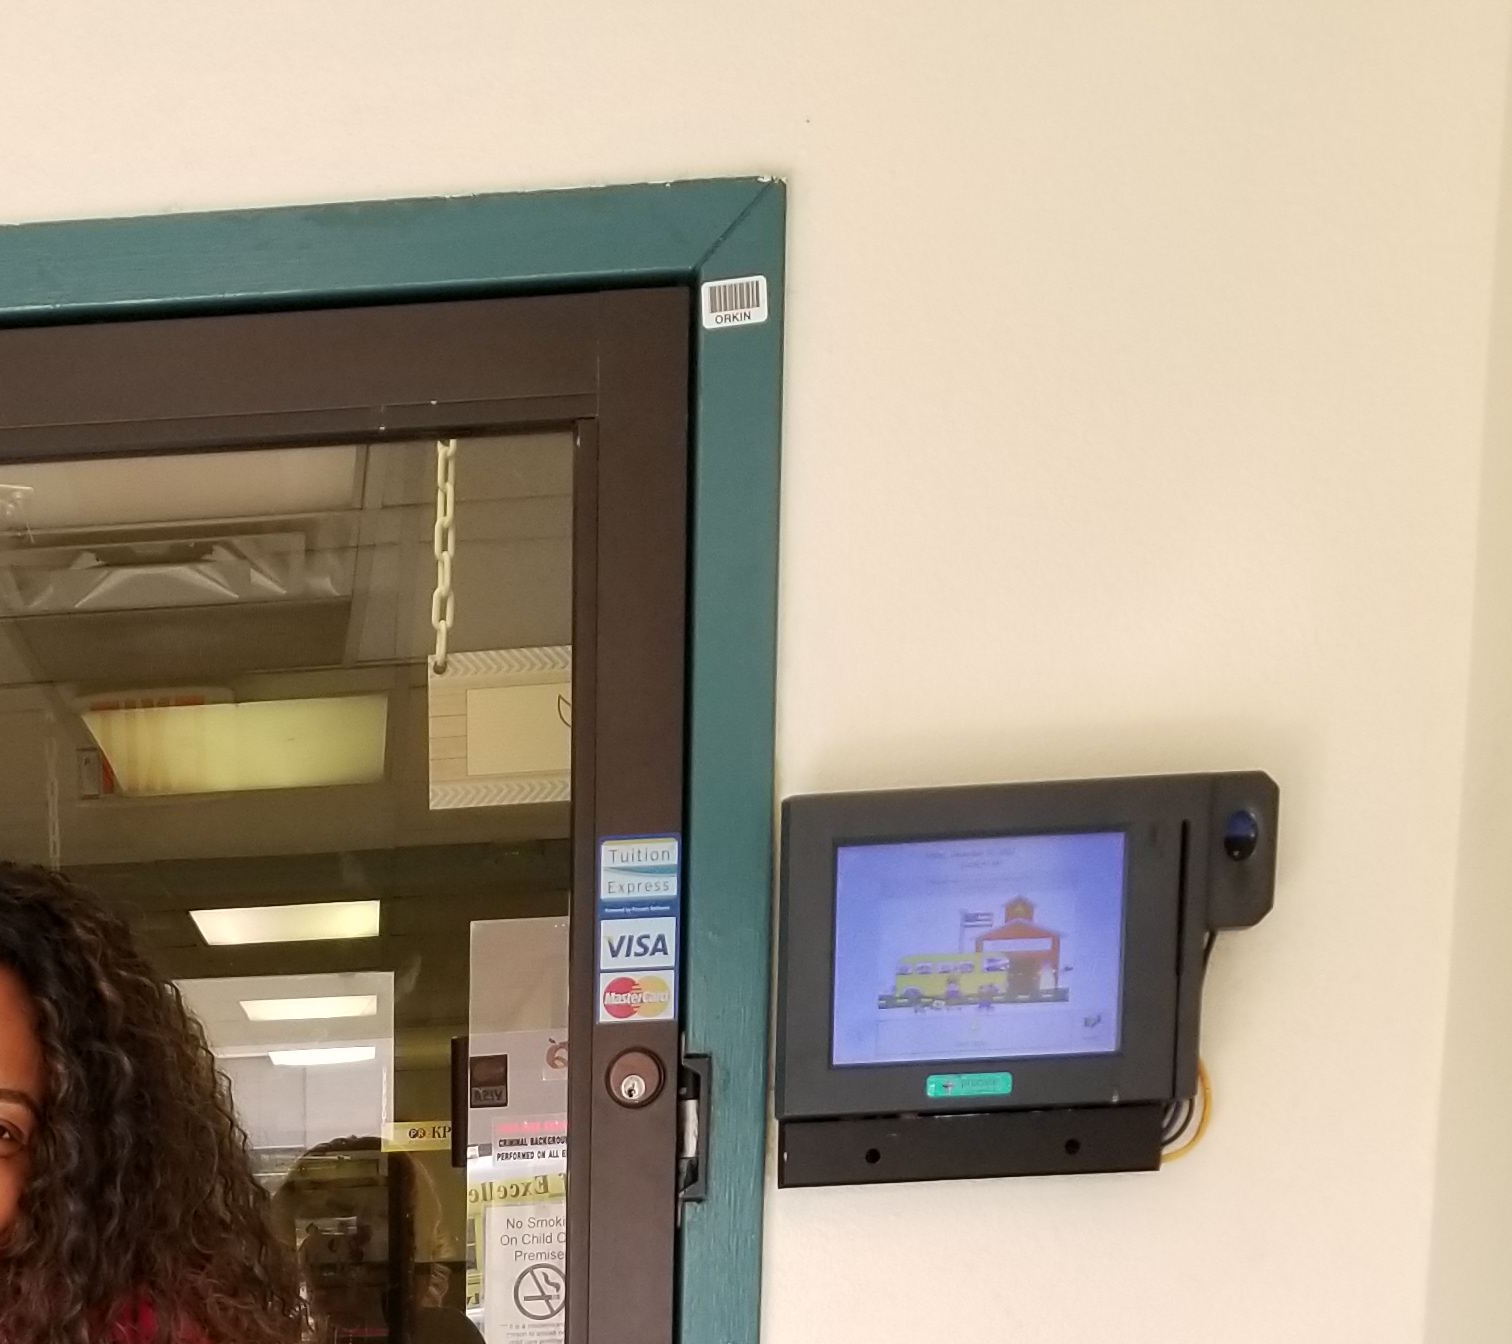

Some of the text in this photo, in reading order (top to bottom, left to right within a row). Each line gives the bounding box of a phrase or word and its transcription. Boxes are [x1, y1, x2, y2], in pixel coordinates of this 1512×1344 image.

[715, 311, 751, 324] ORKIN
[608, 847, 670, 863] Tuition
[608, 881, 670, 895] Express
[606, 933, 669, 958] VISA
[604, 992, 669, 1005] MasterCard
[496, 1151, 534, 1161] PERFORMED
[537, 1150, 546, 1159] ON
[548, 1149, 560, 1159] ALL
[506, 1218, 523, 1229] No
[500, 1235, 518, 1246] On
[521, 1233, 553, 1245] Child
